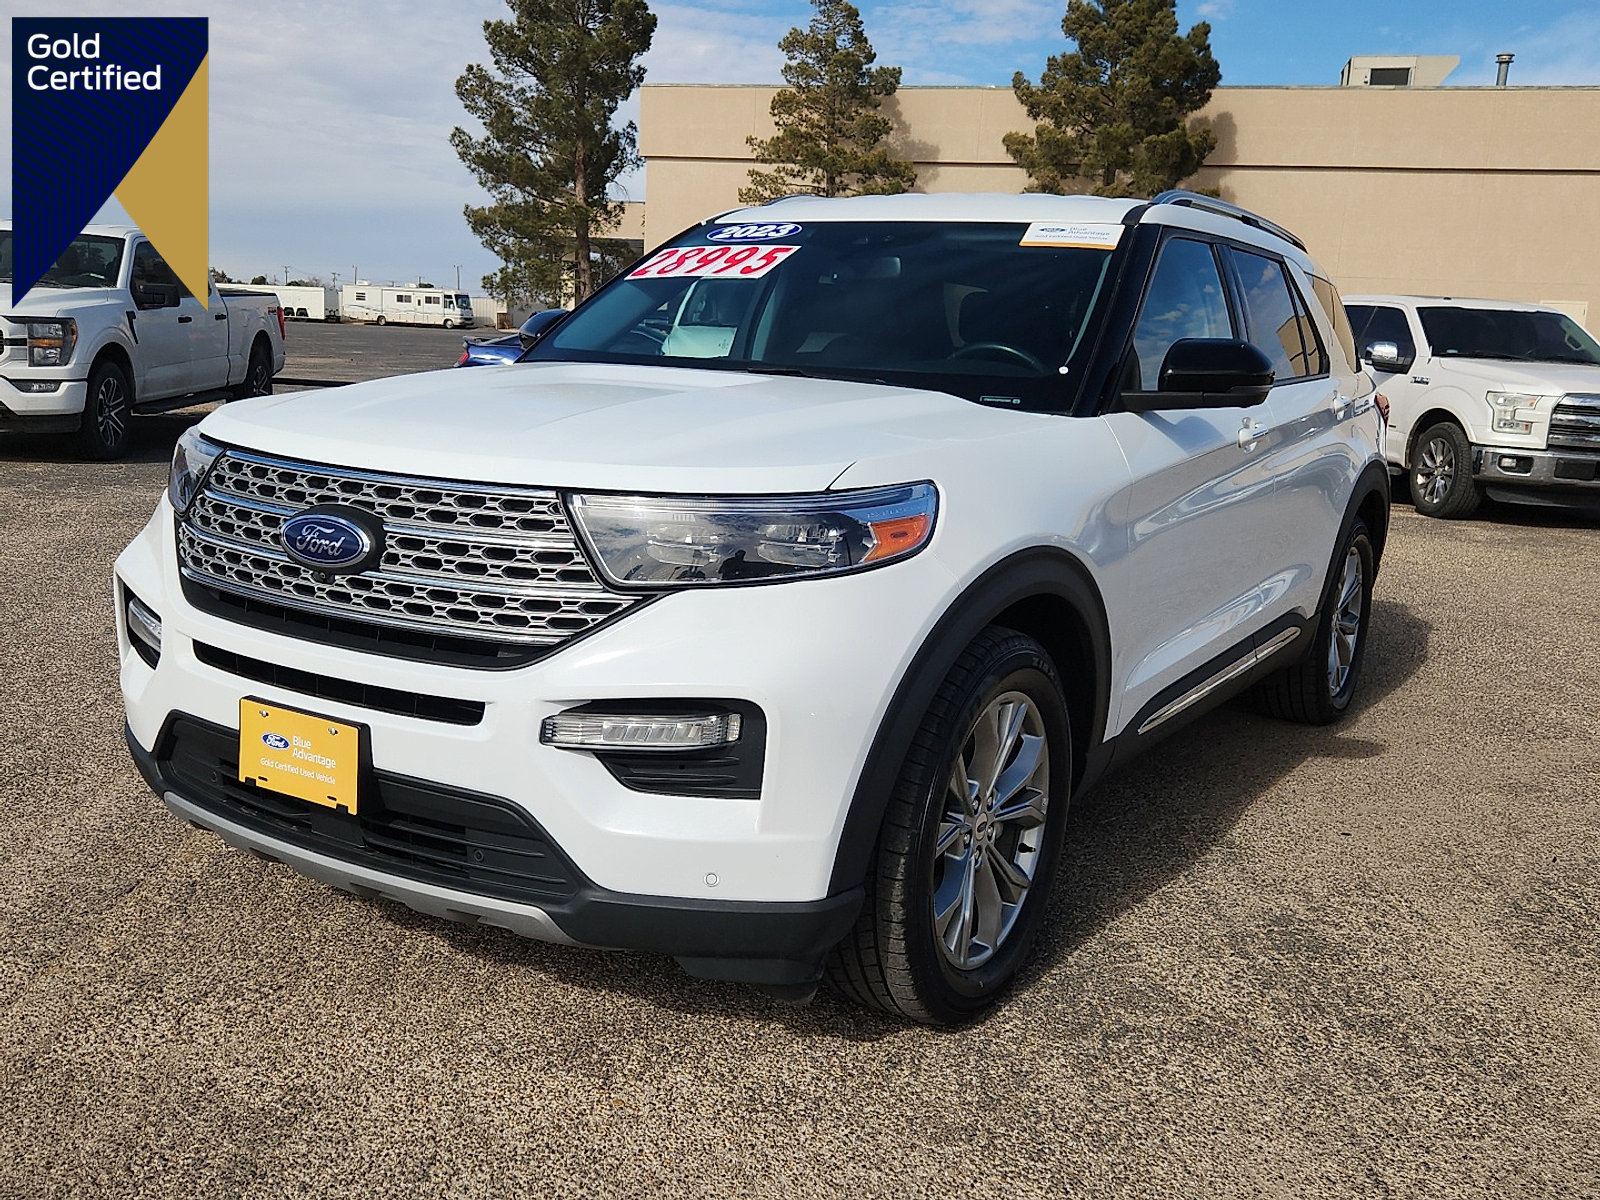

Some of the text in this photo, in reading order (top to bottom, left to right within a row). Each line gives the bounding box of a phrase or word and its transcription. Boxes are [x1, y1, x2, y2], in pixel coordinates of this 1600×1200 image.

[714, 224, 791, 239] 2023
[630, 246, 794, 277] 28995
[295, 523, 346, 556] Ford
[266, 734, 286, 748] Ford
[292, 735, 312, 749] Blue
[292, 748, 337, 769] Advantage
[260, 757, 336, 785] Gold Certified Used Vehicle
